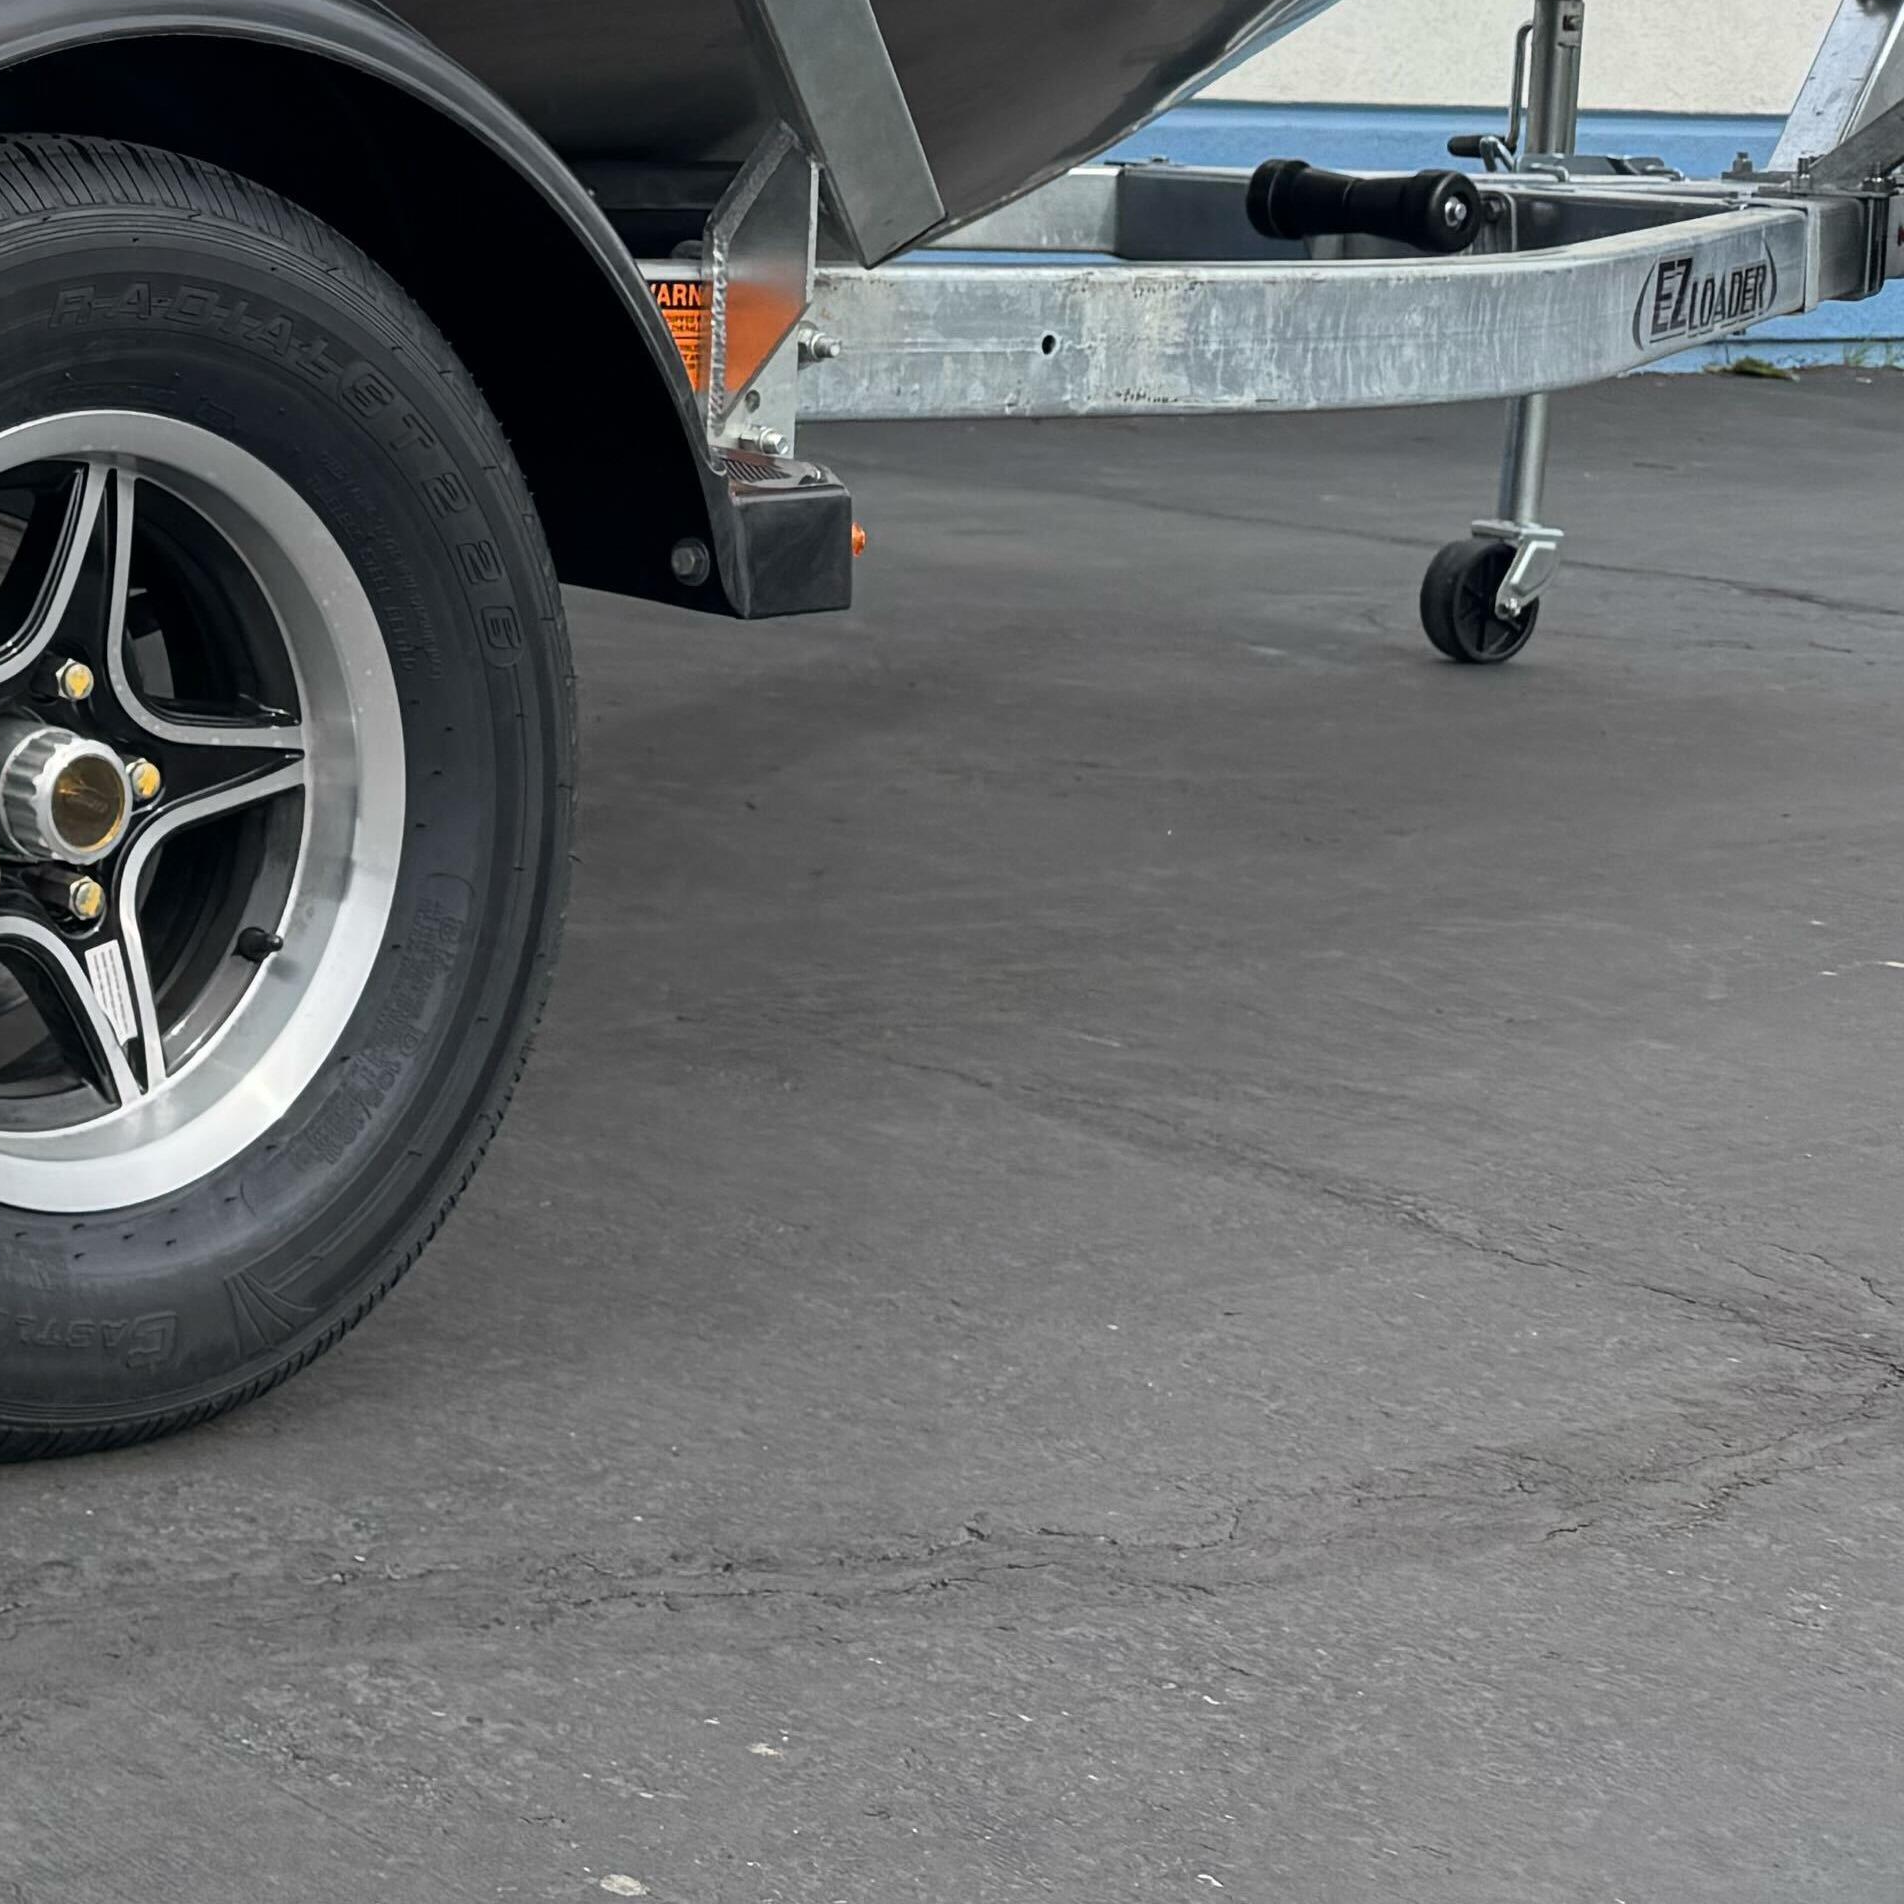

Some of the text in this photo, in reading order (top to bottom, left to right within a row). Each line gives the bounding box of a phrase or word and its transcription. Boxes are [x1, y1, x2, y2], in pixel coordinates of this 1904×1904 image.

[650, 282, 702, 307] ARN
[1650, 256, 1768, 336] EZ LOADER
